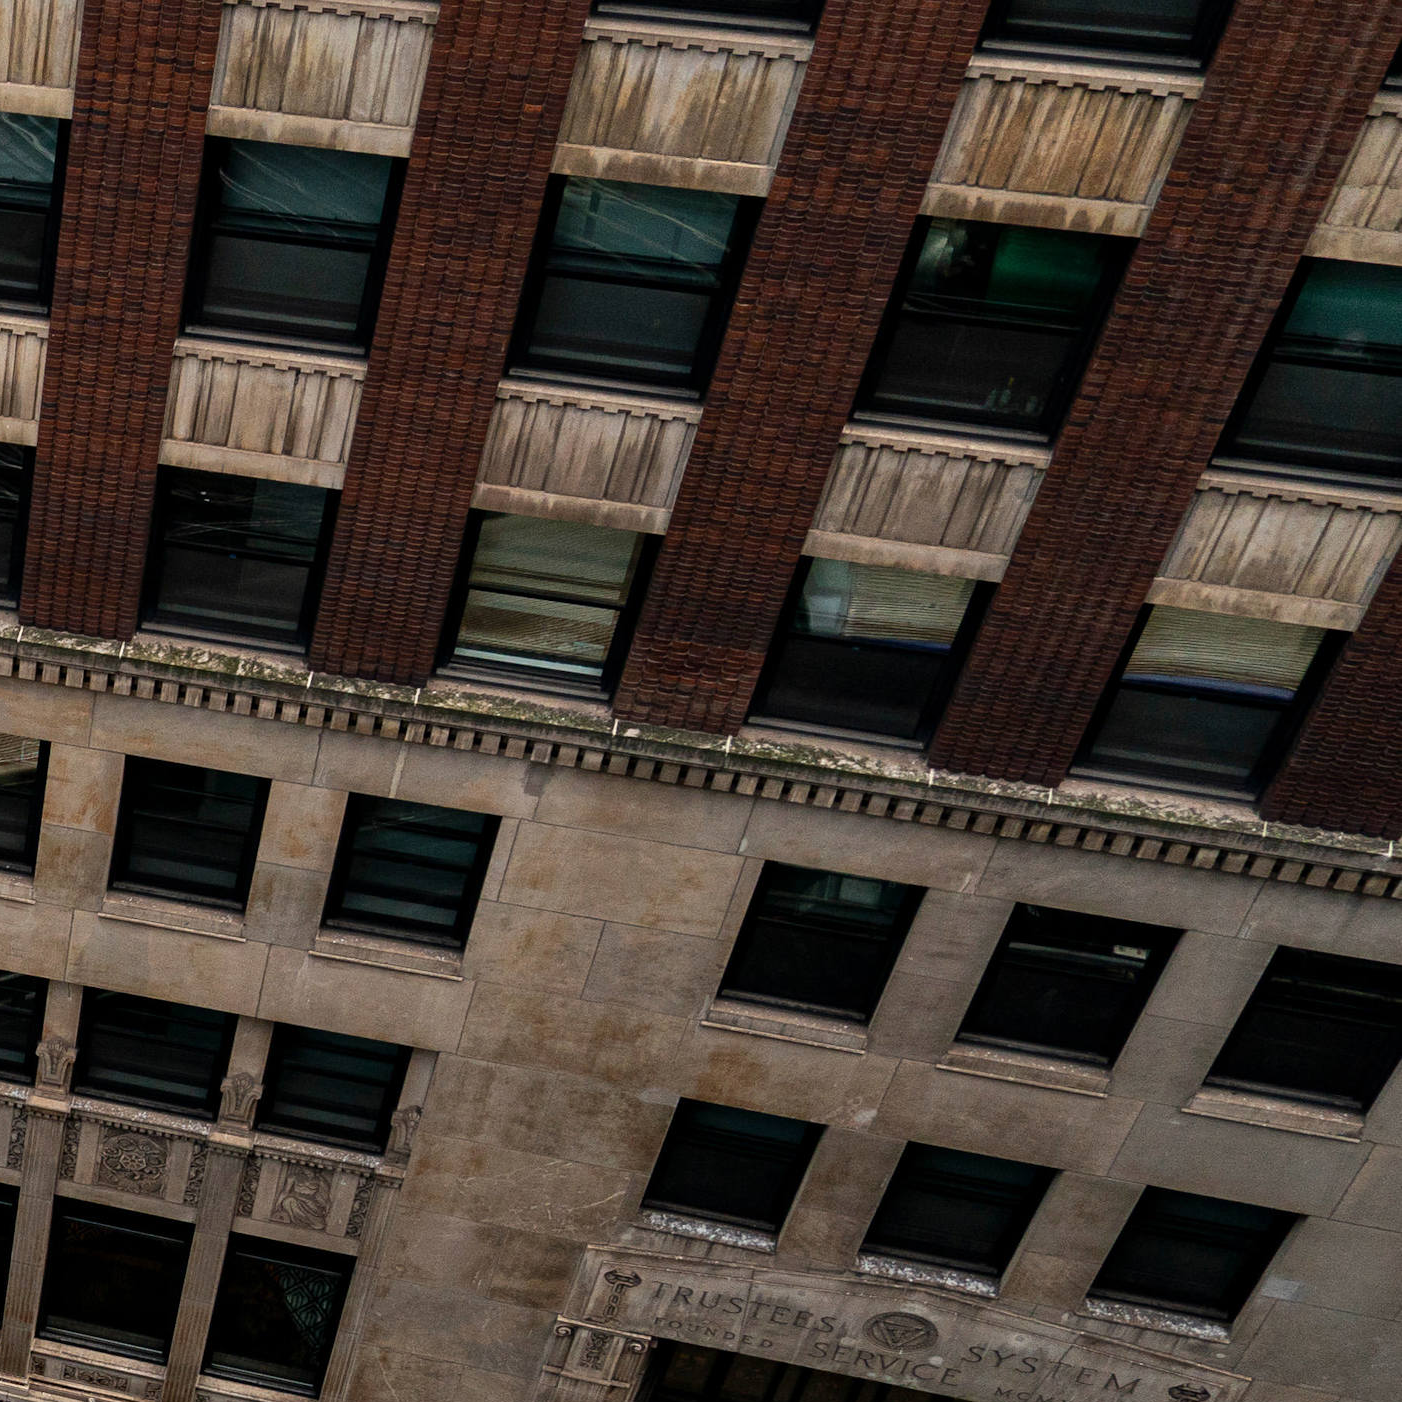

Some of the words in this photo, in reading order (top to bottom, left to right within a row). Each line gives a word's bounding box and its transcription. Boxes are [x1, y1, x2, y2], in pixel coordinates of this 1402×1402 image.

[652, 1281, 837, 1333] TRUSTEES
[654, 1317, 773, 1348] FOUNDED
[808, 1342, 962, 1387] SERVICE
[960, 1346, 1143, 1395] SYSTEM
